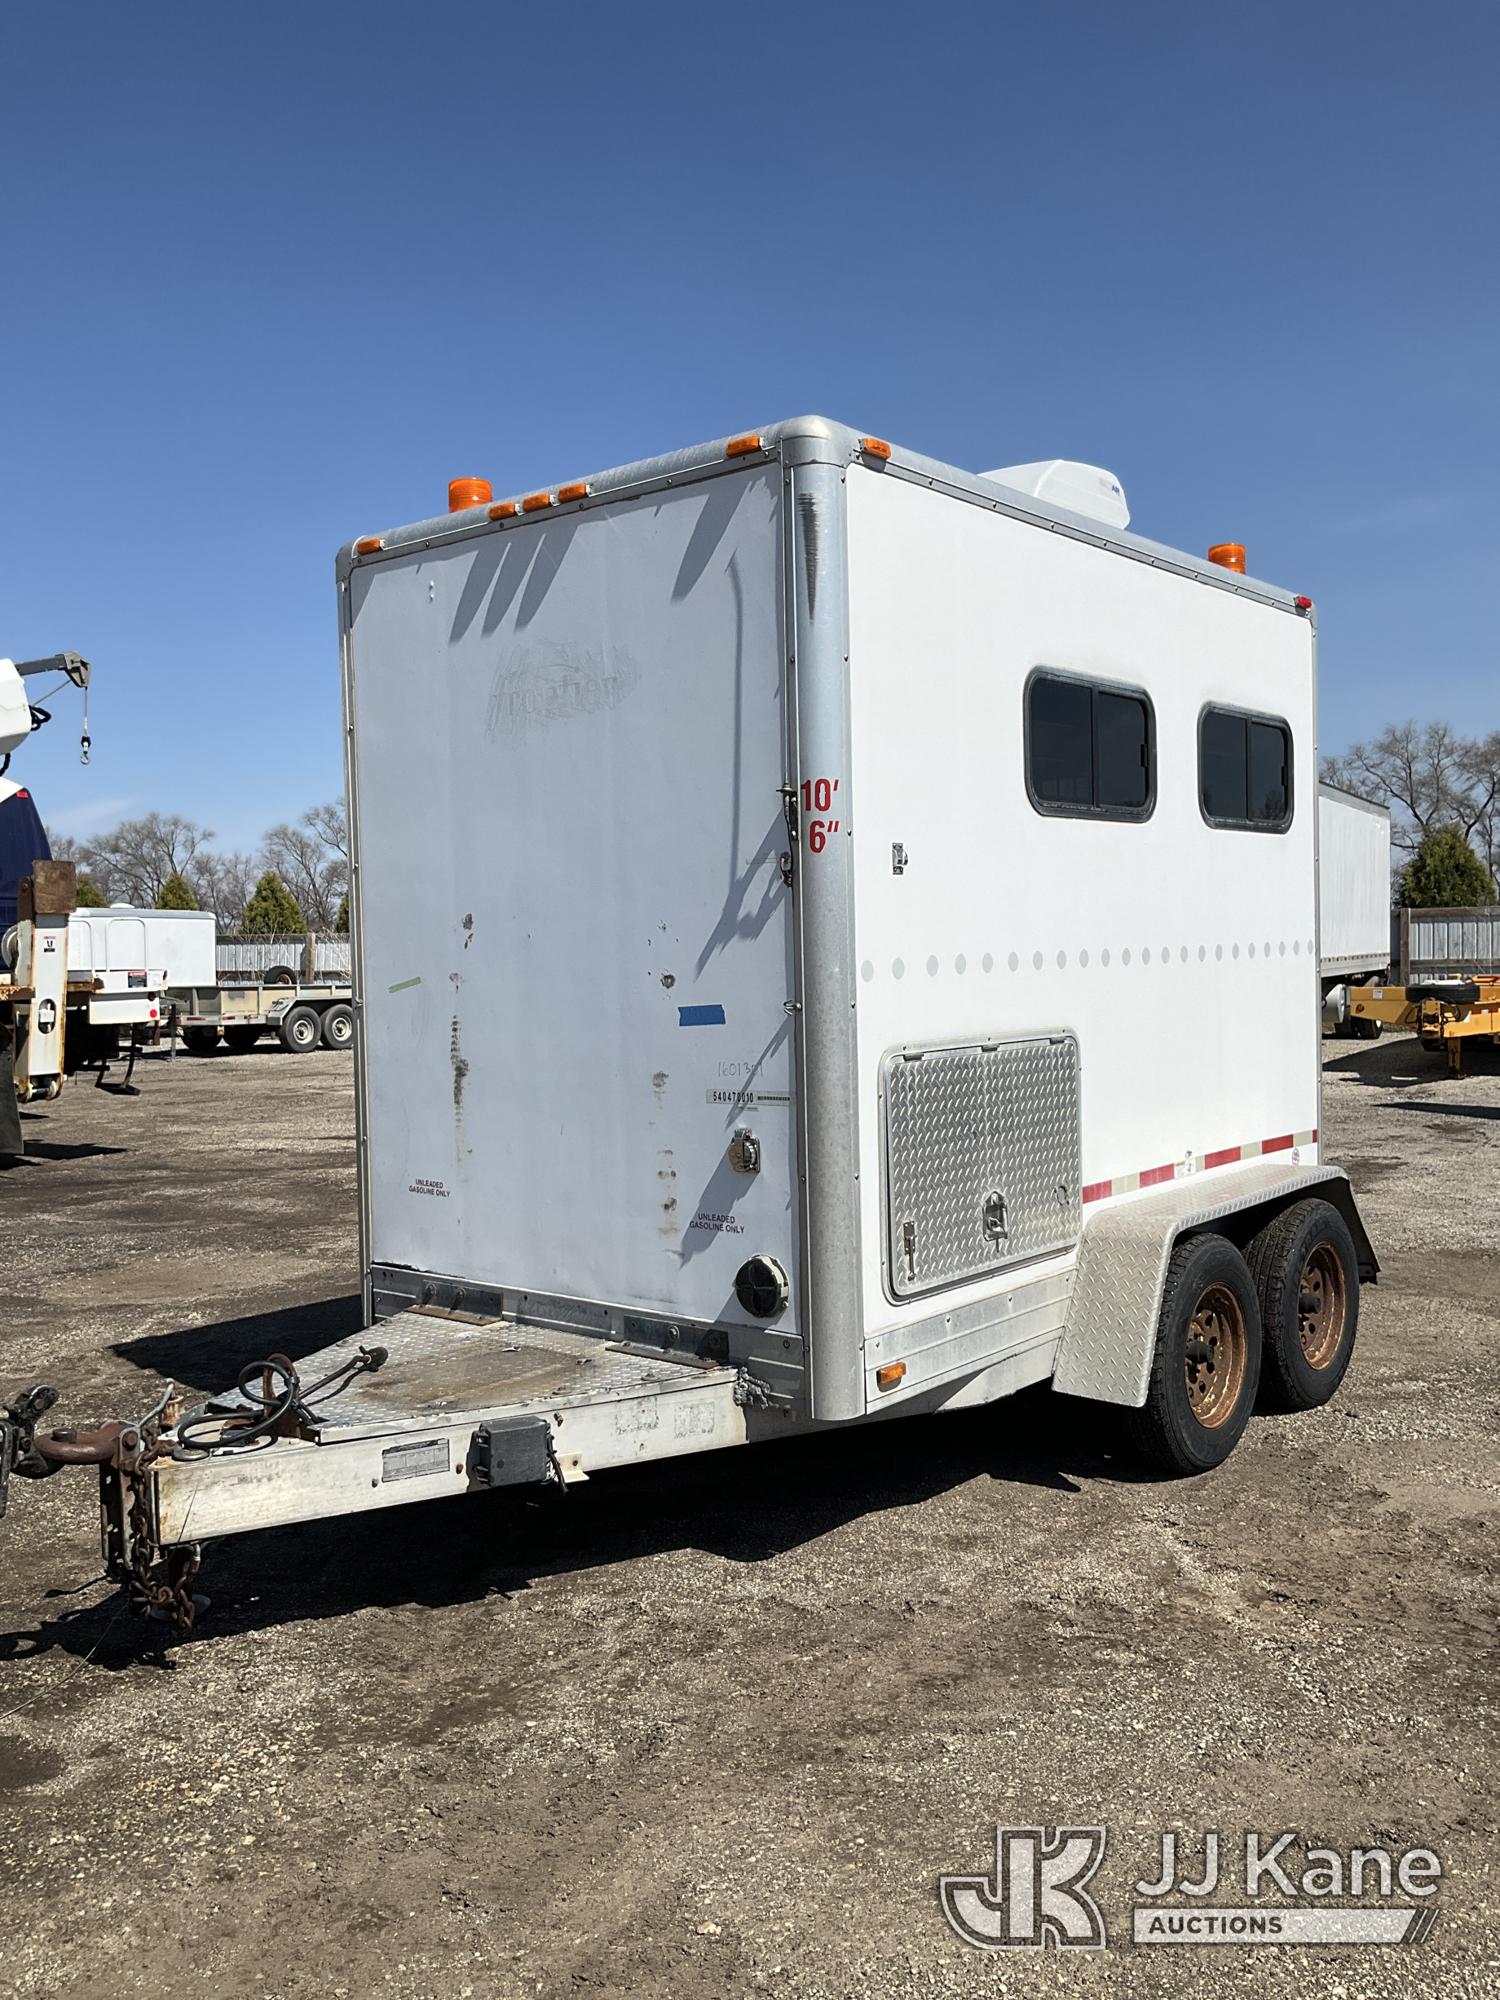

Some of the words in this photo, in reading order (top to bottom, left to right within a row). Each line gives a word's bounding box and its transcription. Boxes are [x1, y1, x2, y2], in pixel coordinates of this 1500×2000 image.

[801, 778, 840, 812] 10'
[415, 1178, 444, 1189] UNLEADED
[408, 1185, 435, 1196] GASOLINE
[435, 1189, 451, 1198] ONLY
[697, 1212, 736, 1224] UNLEADED
[689, 1220, 724, 1232] GASOLINE
[725, 1224, 745, 1234] ONLY
